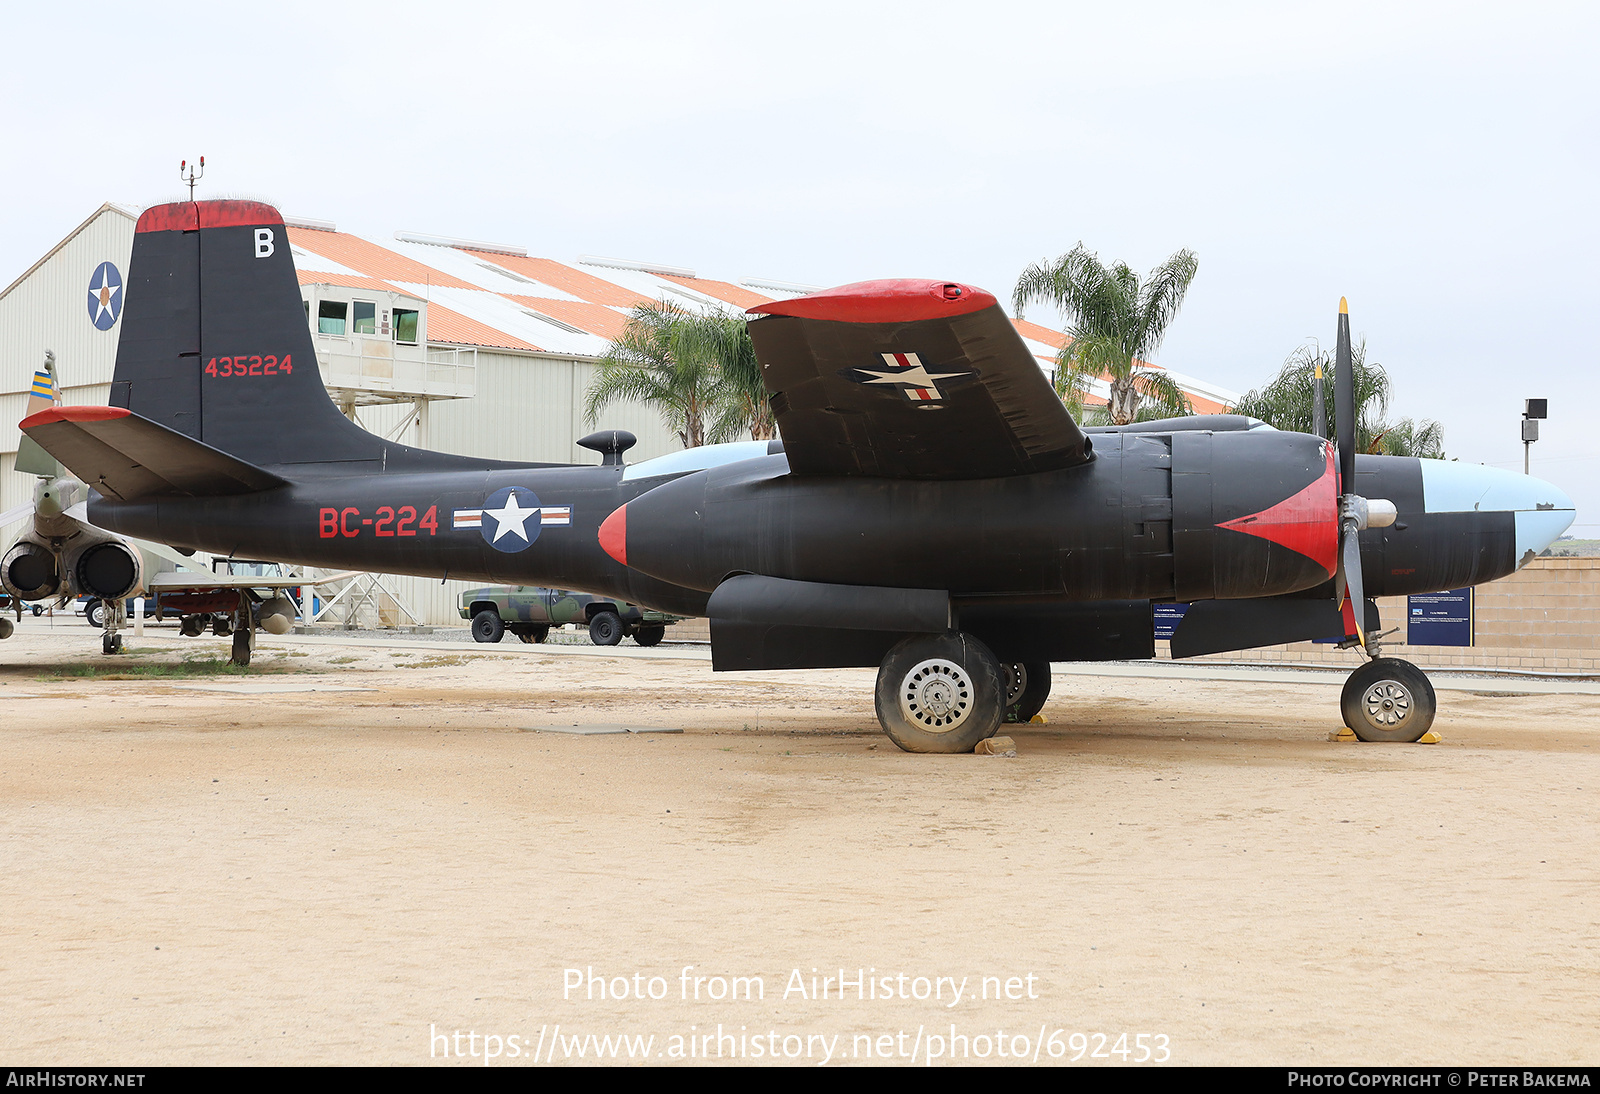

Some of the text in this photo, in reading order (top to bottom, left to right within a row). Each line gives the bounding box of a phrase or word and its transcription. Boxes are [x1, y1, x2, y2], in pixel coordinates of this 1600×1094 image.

[254, 228, 275, 258] B
[204, 354, 293, 378] 435224
[319, 505, 438, 538] BC-224
